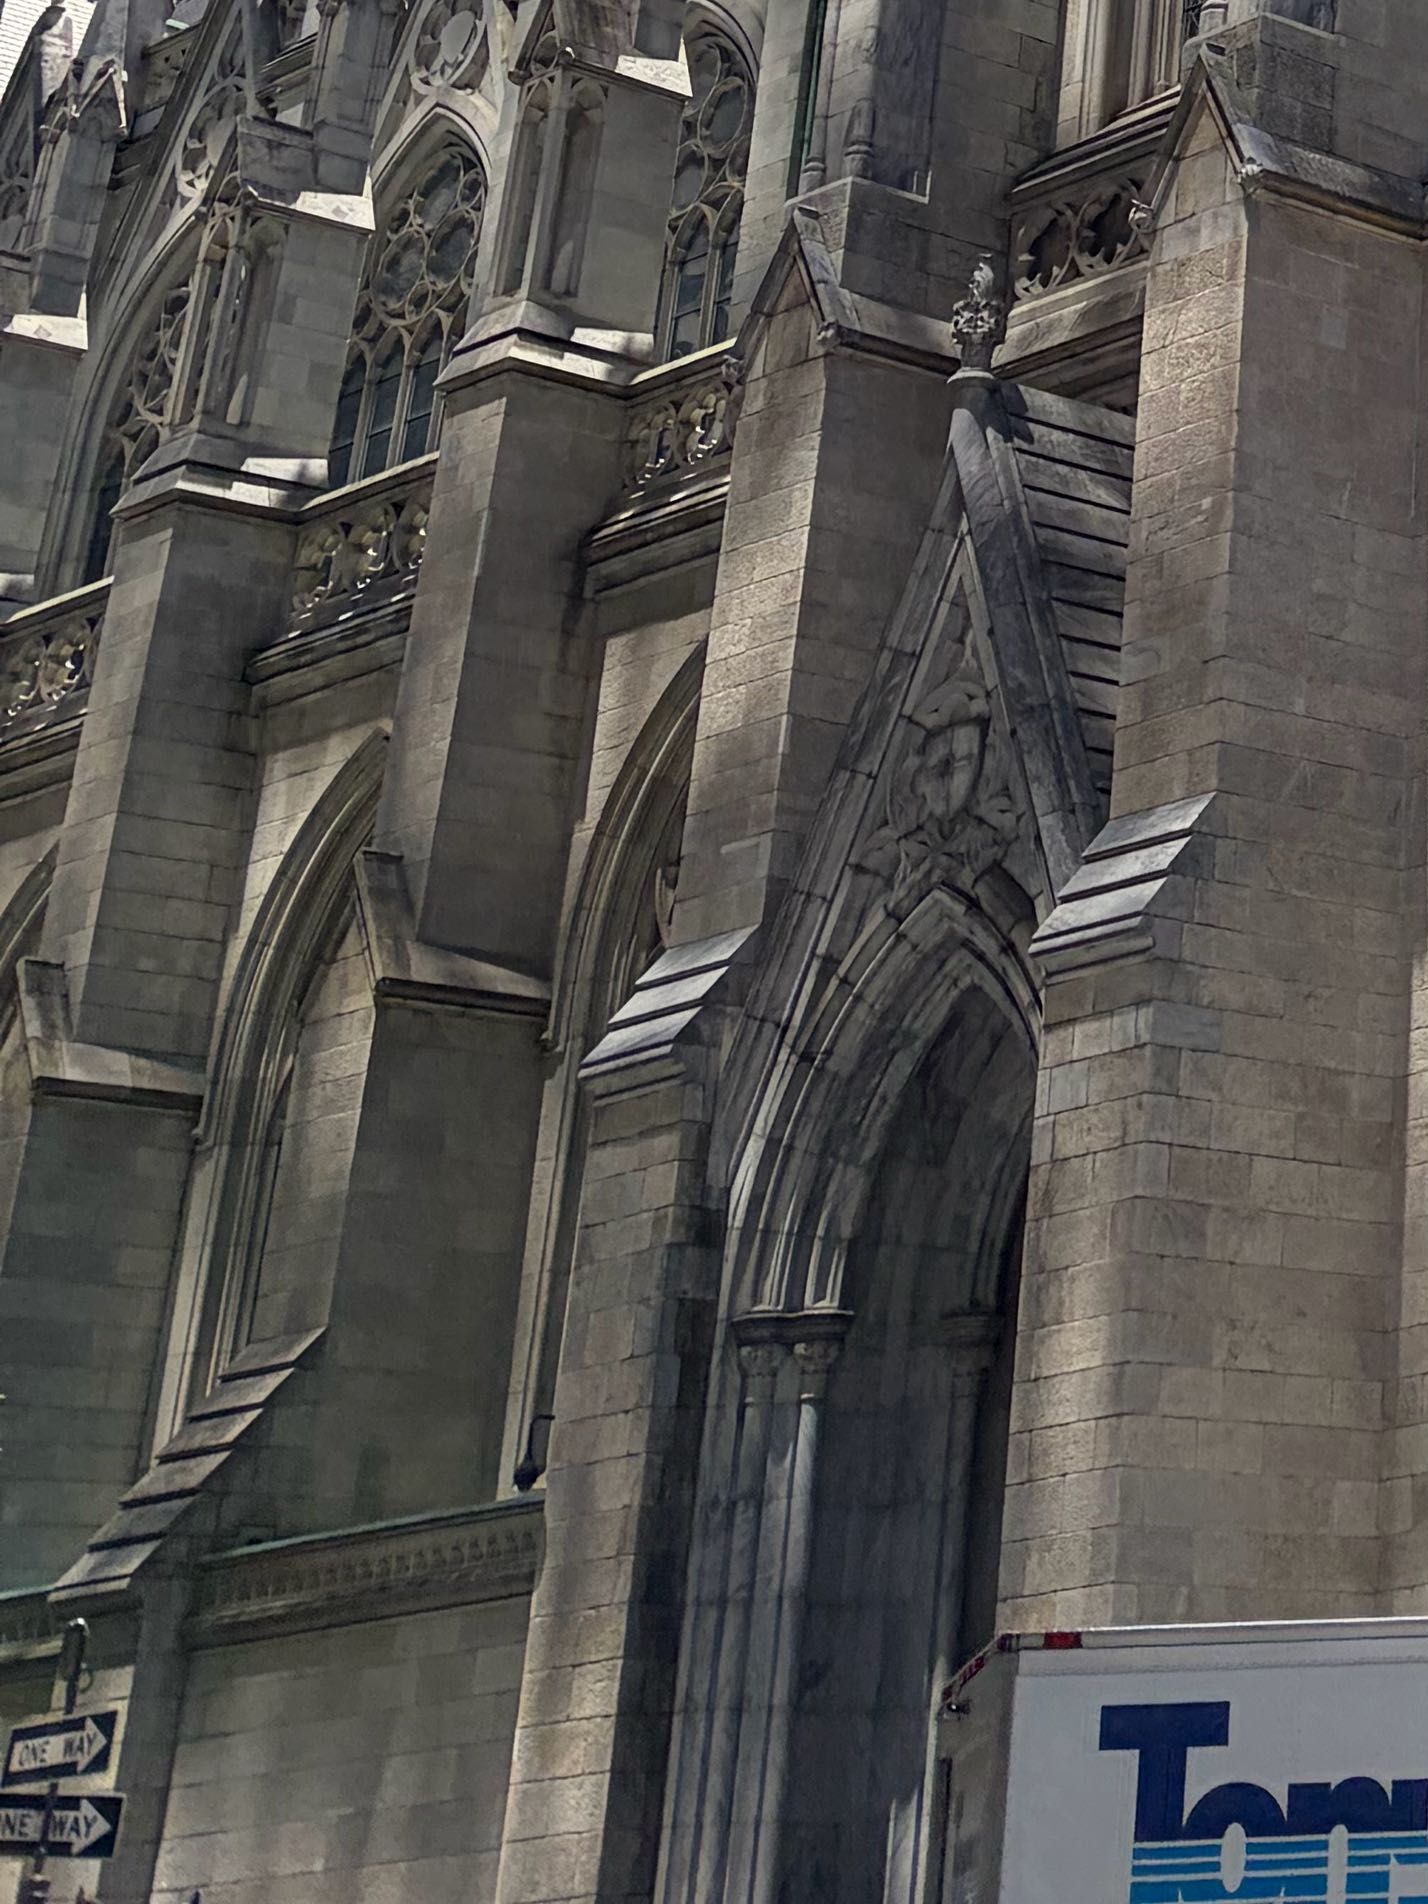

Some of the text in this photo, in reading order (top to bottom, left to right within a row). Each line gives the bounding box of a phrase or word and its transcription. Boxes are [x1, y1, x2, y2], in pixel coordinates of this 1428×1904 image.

[18, 1731, 97, 1768] ONE WAY
[0, 1813, 98, 1839] NE WAY
